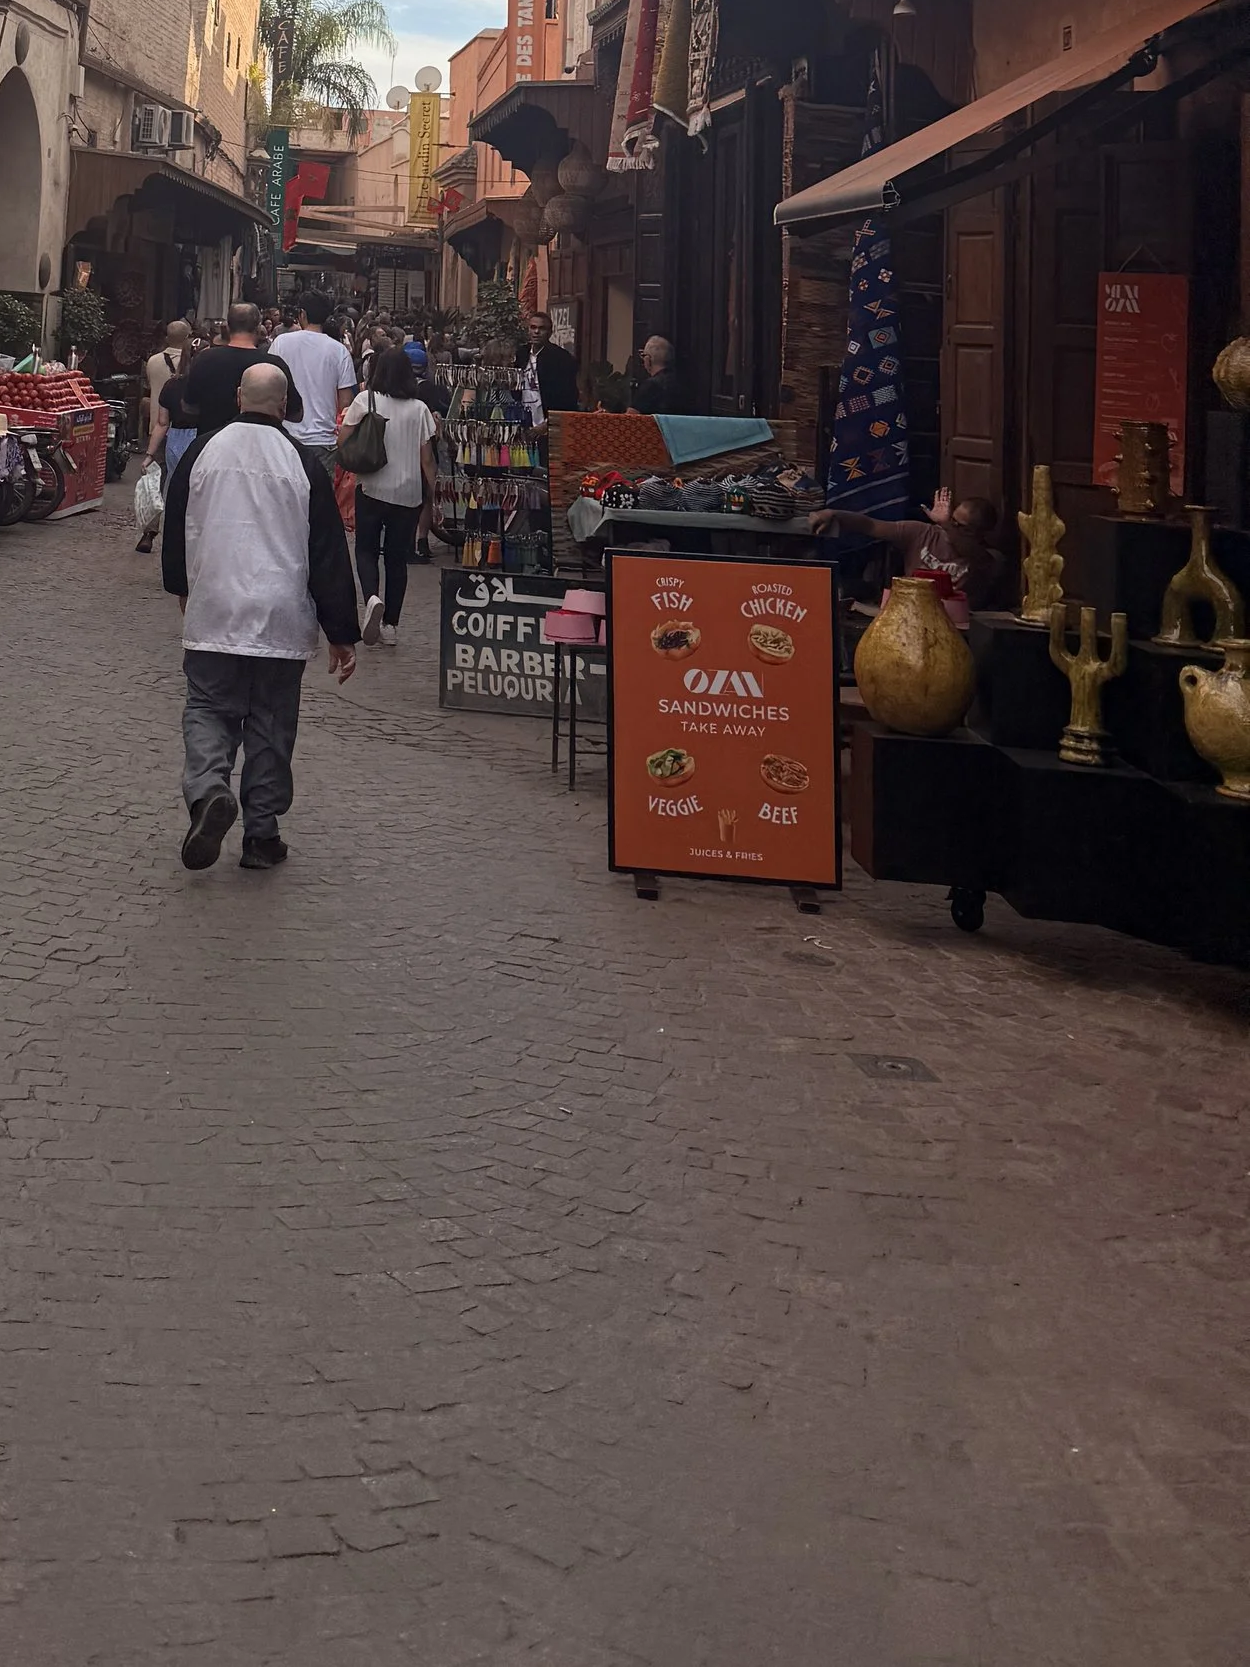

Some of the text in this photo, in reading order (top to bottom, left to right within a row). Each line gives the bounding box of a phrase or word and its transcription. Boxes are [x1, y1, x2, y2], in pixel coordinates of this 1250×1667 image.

[278, 20, 290, 74] CAFE
[516, 35, 533, 66] DES
[418, 101, 431, 139] Secret
[271, 145, 285, 226] CAFE ARABE
[456, 574, 565, 608] لاق
[655, 577, 685, 589] CRISPY
[751, 583, 793, 597] ROASTED
[650, 591, 693, 612] FISH
[740, 597, 807, 623] CHICKEN
[452, 610, 554, 645] COIFF
[455, 643, 585, 680] BARBER
[447, 669, 582, 705] PELUQURA
[658, 699, 790, 721] SANDWICHES
[681, 721, 766, 738] TAKE AWAY
[648, 795, 704, 817] VEGGIE
[758, 802, 798, 825] BEEF
[689, 847, 764, 862] JUICES & FRIES
